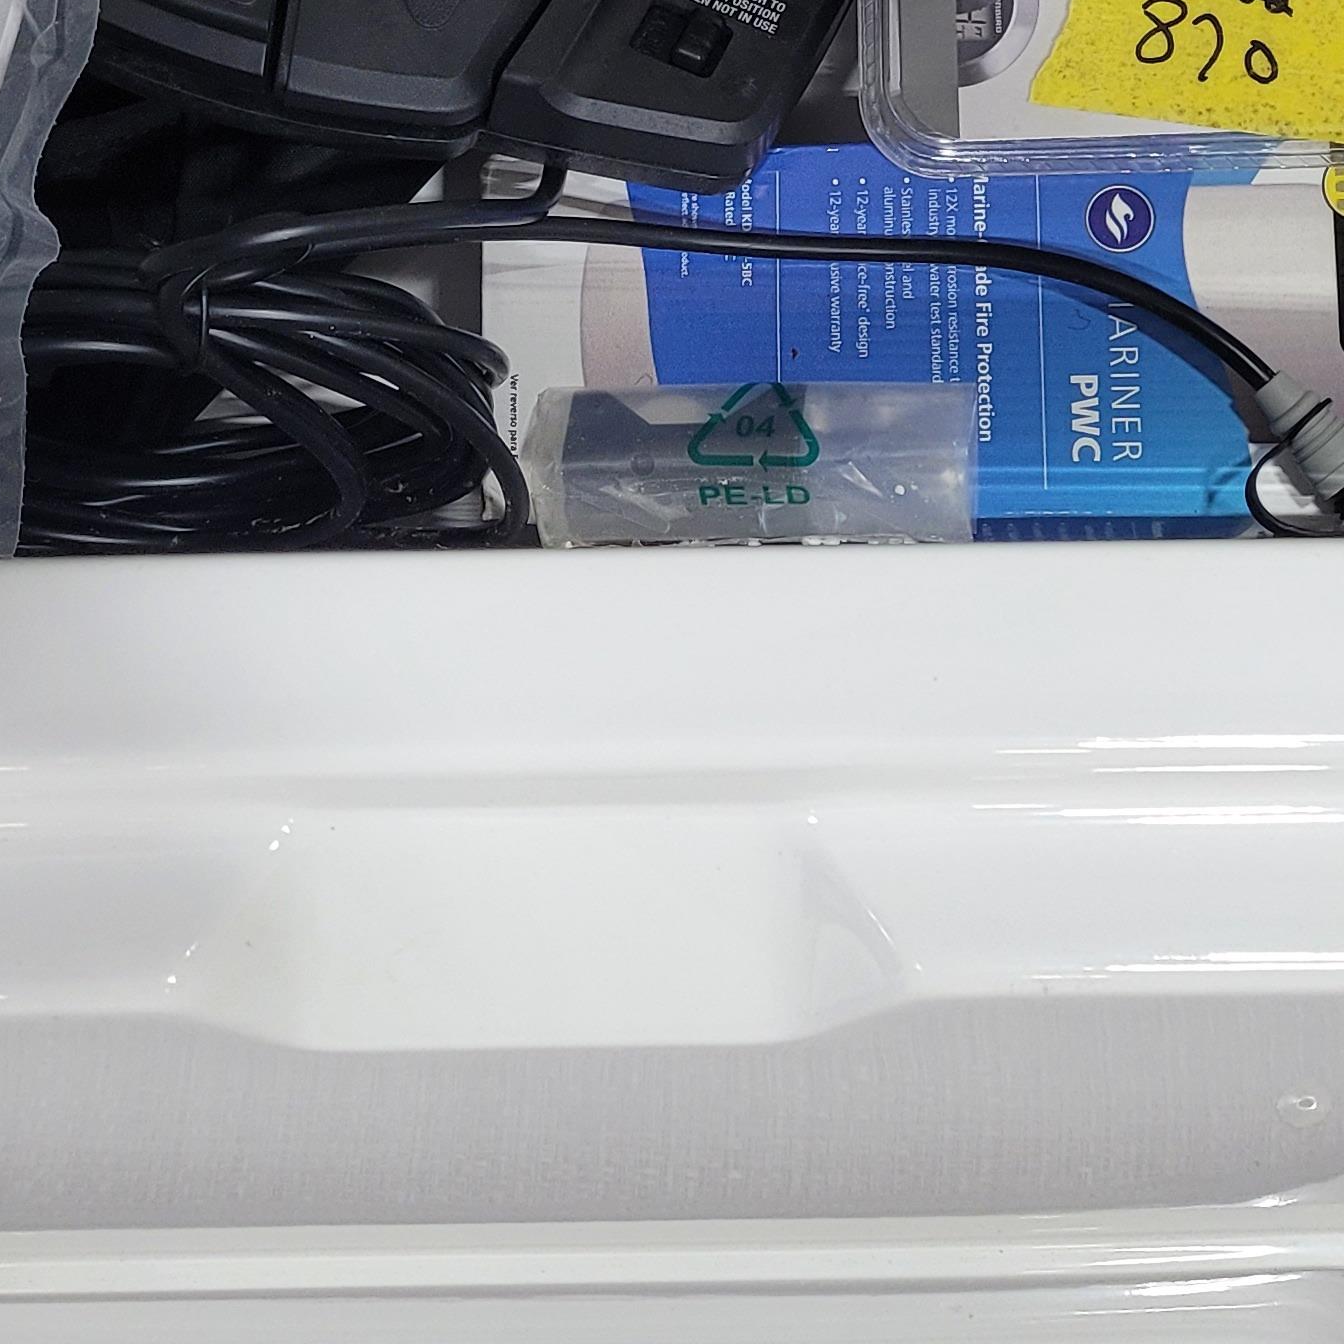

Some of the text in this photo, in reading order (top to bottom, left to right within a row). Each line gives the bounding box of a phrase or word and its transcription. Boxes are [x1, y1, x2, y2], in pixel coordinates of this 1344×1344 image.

[712, 0, 738, 17] NOT
[737, 11, 753, 24] IN
[753, 17, 779, 35] USE
[724, 191, 737, 226] Rated
[926, 188, 941, 236] industry
[945, 188, 958, 212] 12X
[883, 186, 898, 329] aluminu onstruction
[902, 275, 915, 299] and
[828, 295, 844, 353] warranty
[929, 302, 942, 325] test
[975, 302, 993, 337] Fire
[854, 317, 871, 359] design
[948, 312, 960, 373] resistance
[509, 374, 519, 391] Ver
[976, 342, 996, 442] Protection
[510, 393, 519, 427] reverso
[735, 414, 777, 438] 04
[1069, 373, 1103, 463] PWC
[507, 430, 519, 452] para
[699, 485, 811, 506] PE-LD
